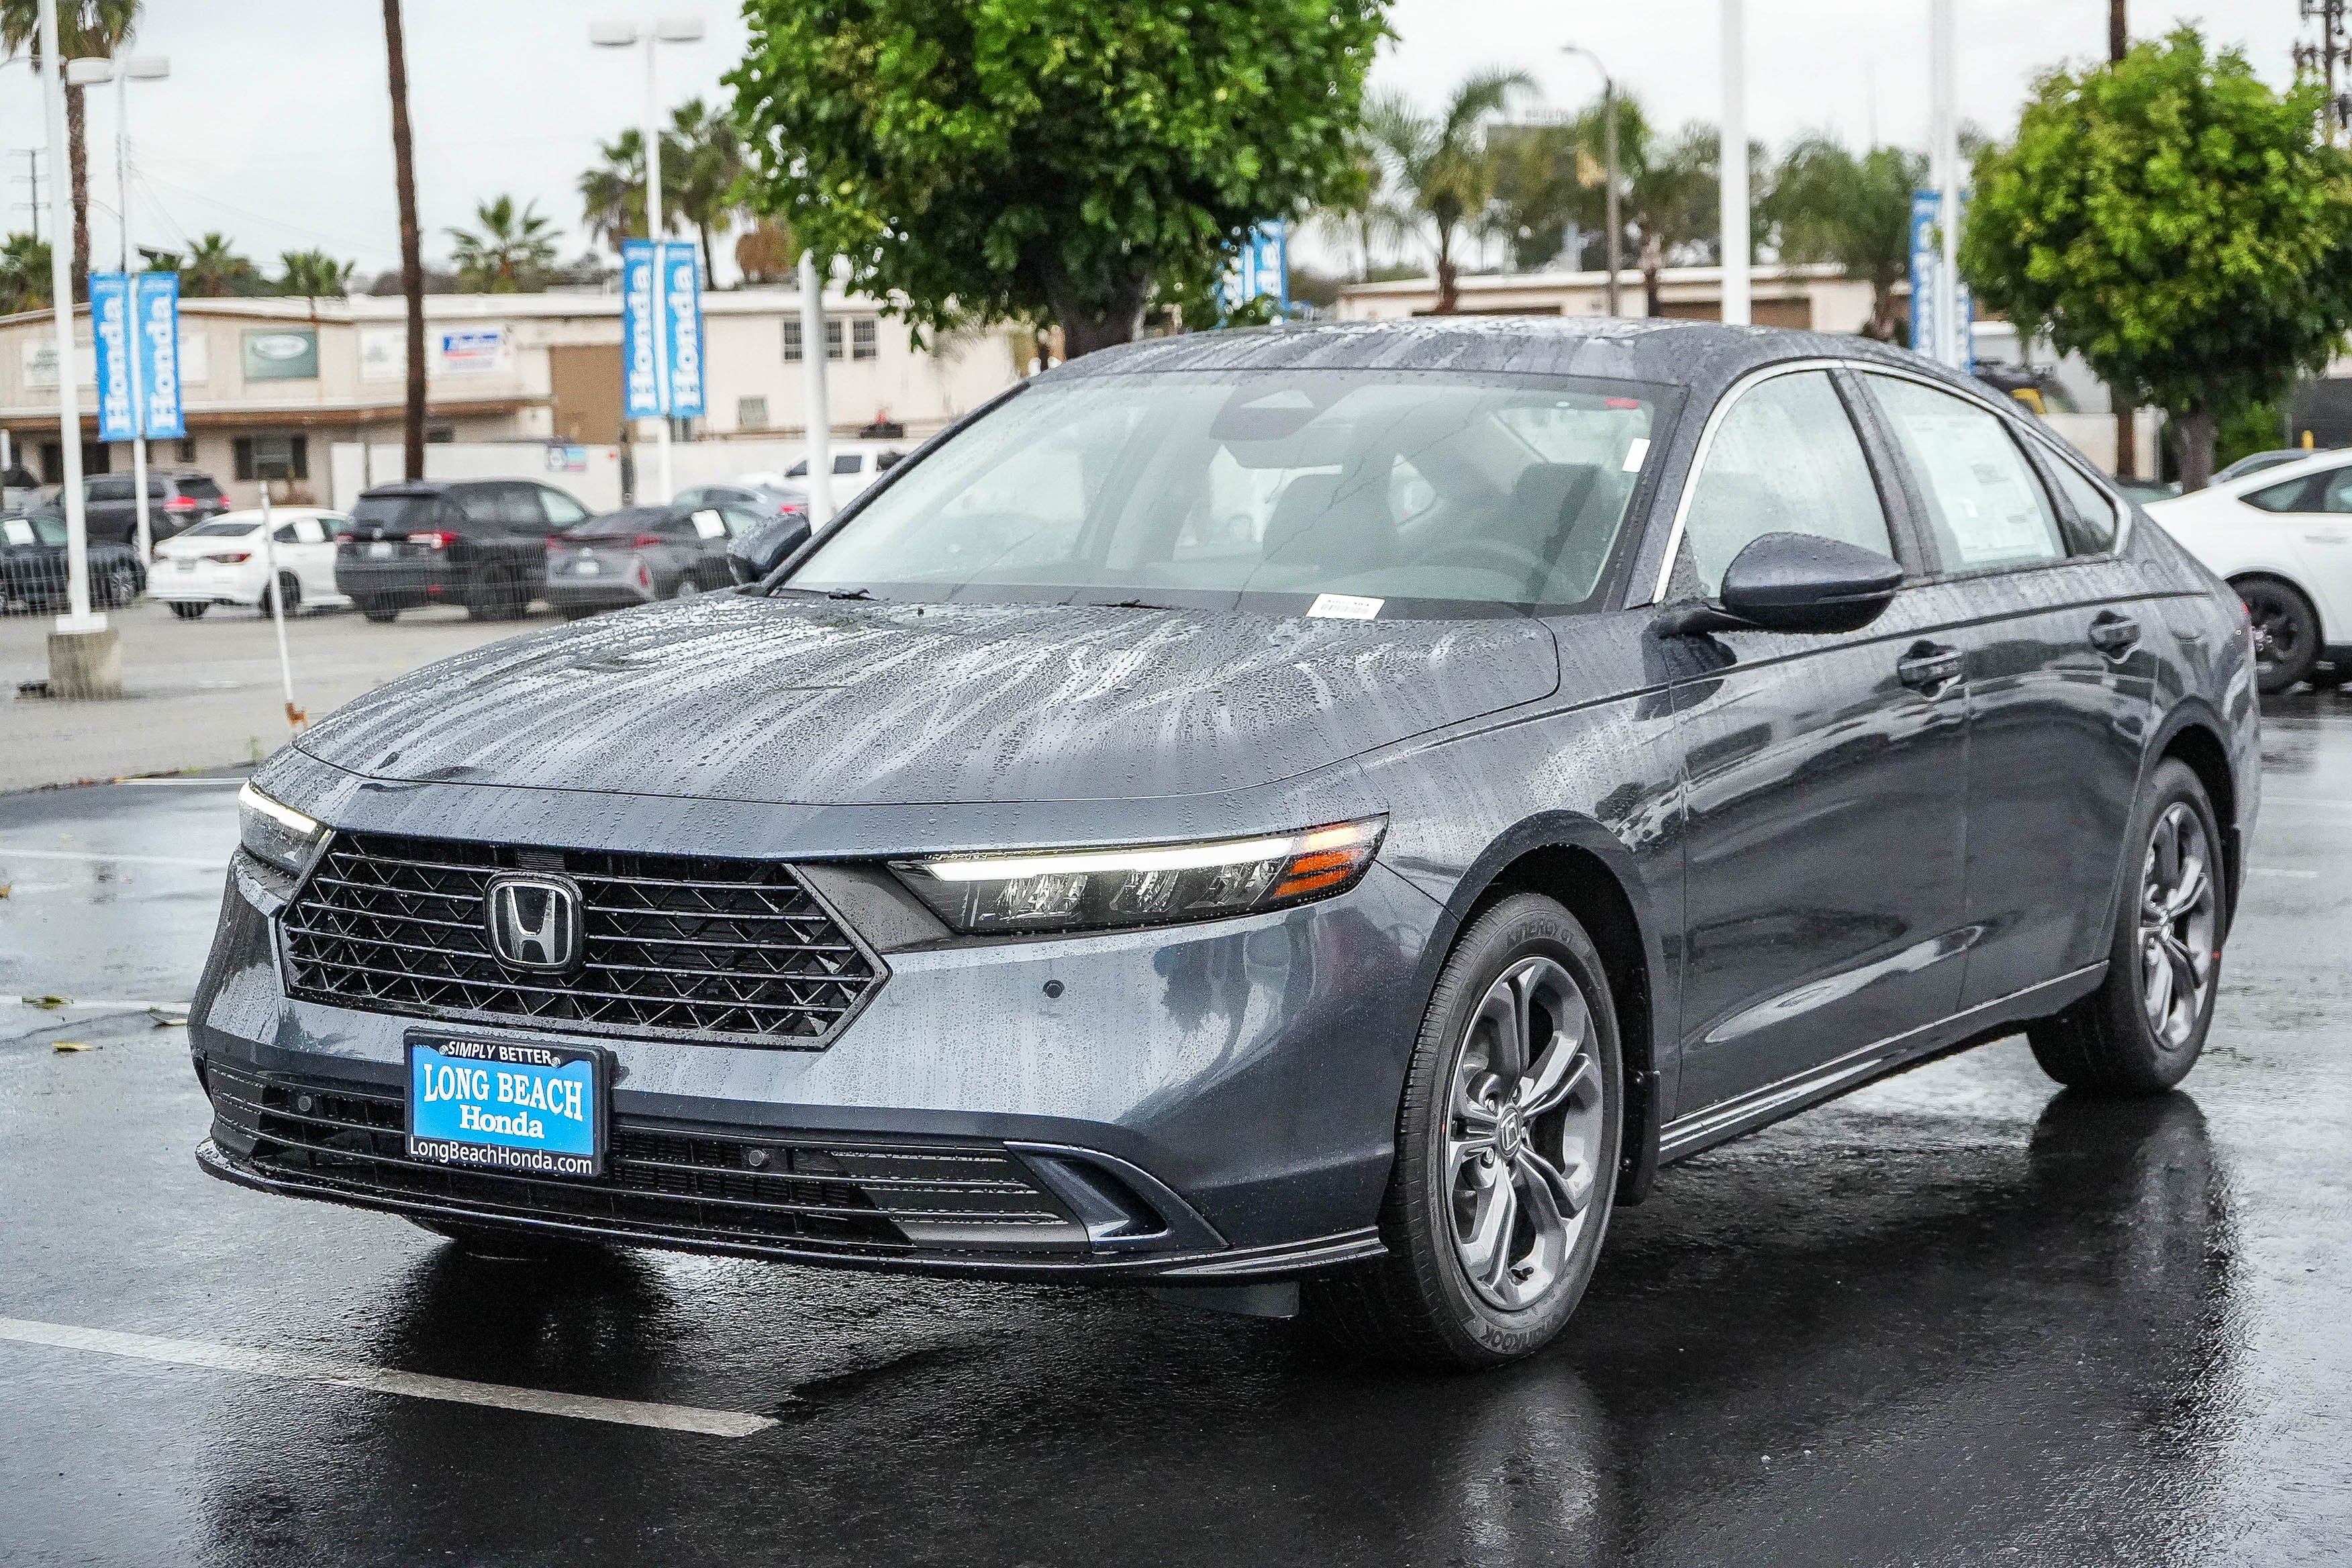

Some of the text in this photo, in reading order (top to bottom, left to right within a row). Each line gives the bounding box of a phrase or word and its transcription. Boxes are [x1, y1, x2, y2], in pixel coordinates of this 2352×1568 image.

[99, 296, 131, 430] Honda
[146, 295, 177, 428] Honda
[627, 264, 657, 410] Honda
[669, 265, 701, 407] Honda
[424, 1063, 583, 1122] LONG BEACH
[448, 1041, 551, 1065] SIMPLY BETTER
[410, 1136, 592, 1174] LongBeachHonda.com
[459, 1104, 545, 1139] Honda
